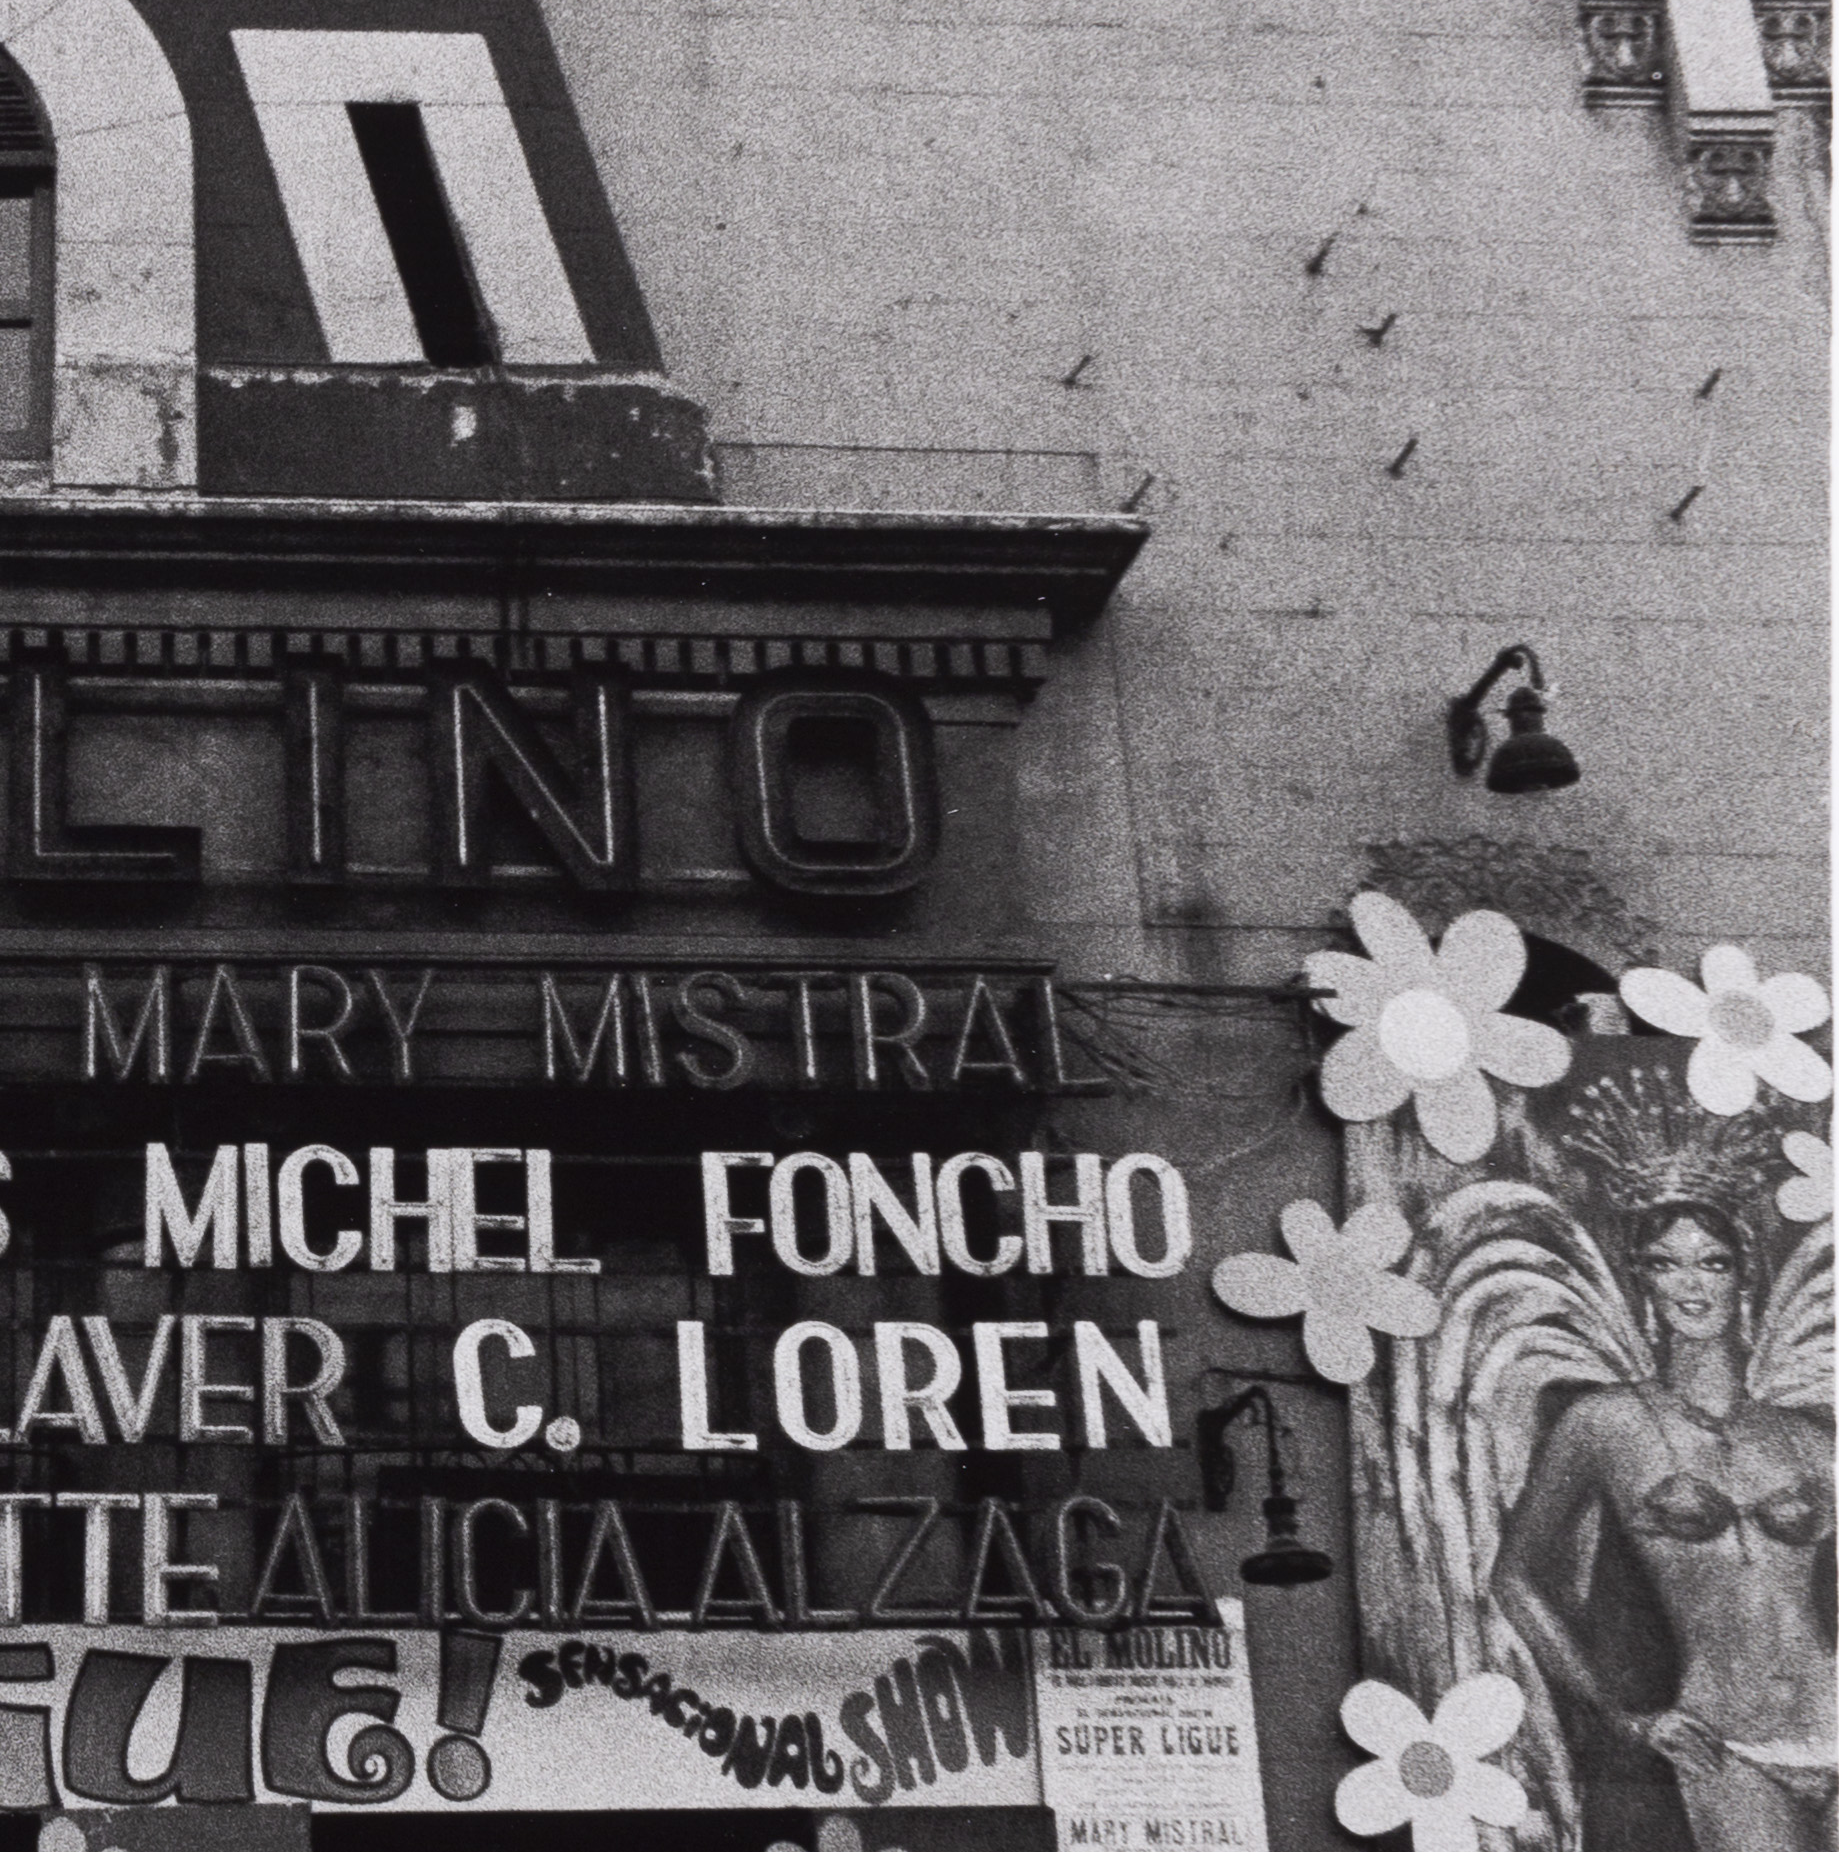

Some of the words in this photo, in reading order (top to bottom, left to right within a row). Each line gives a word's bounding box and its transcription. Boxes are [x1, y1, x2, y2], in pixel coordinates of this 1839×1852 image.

[81, 963, 437, 1084] MARY
[540, 968, 1110, 1089] MISTRAL
[144, 1141, 601, 1276] MICHEL
[700, 1150, 1192, 1279] FONCHO
[452, 1318, 582, 1451] C.
[676, 1318, 1172, 1451] LOREN
[251, 1493, 658, 1629] ALICIA
[693, 1493, 1225, 1631] ALZAGA
[1049, 1629, 1094, 1669] EL
[1106, 1627, 1233, 1669] MOLINO
[840, 1629, 1036, 1805] SHOW
[1056, 1724, 1145, 1755] SUPER
[1161, 1724, 1239, 1755] LIGUE
[1071, 1819, 1129, 1845] MARY
[1145, 1819, 1244, 1846] MISTRAL
